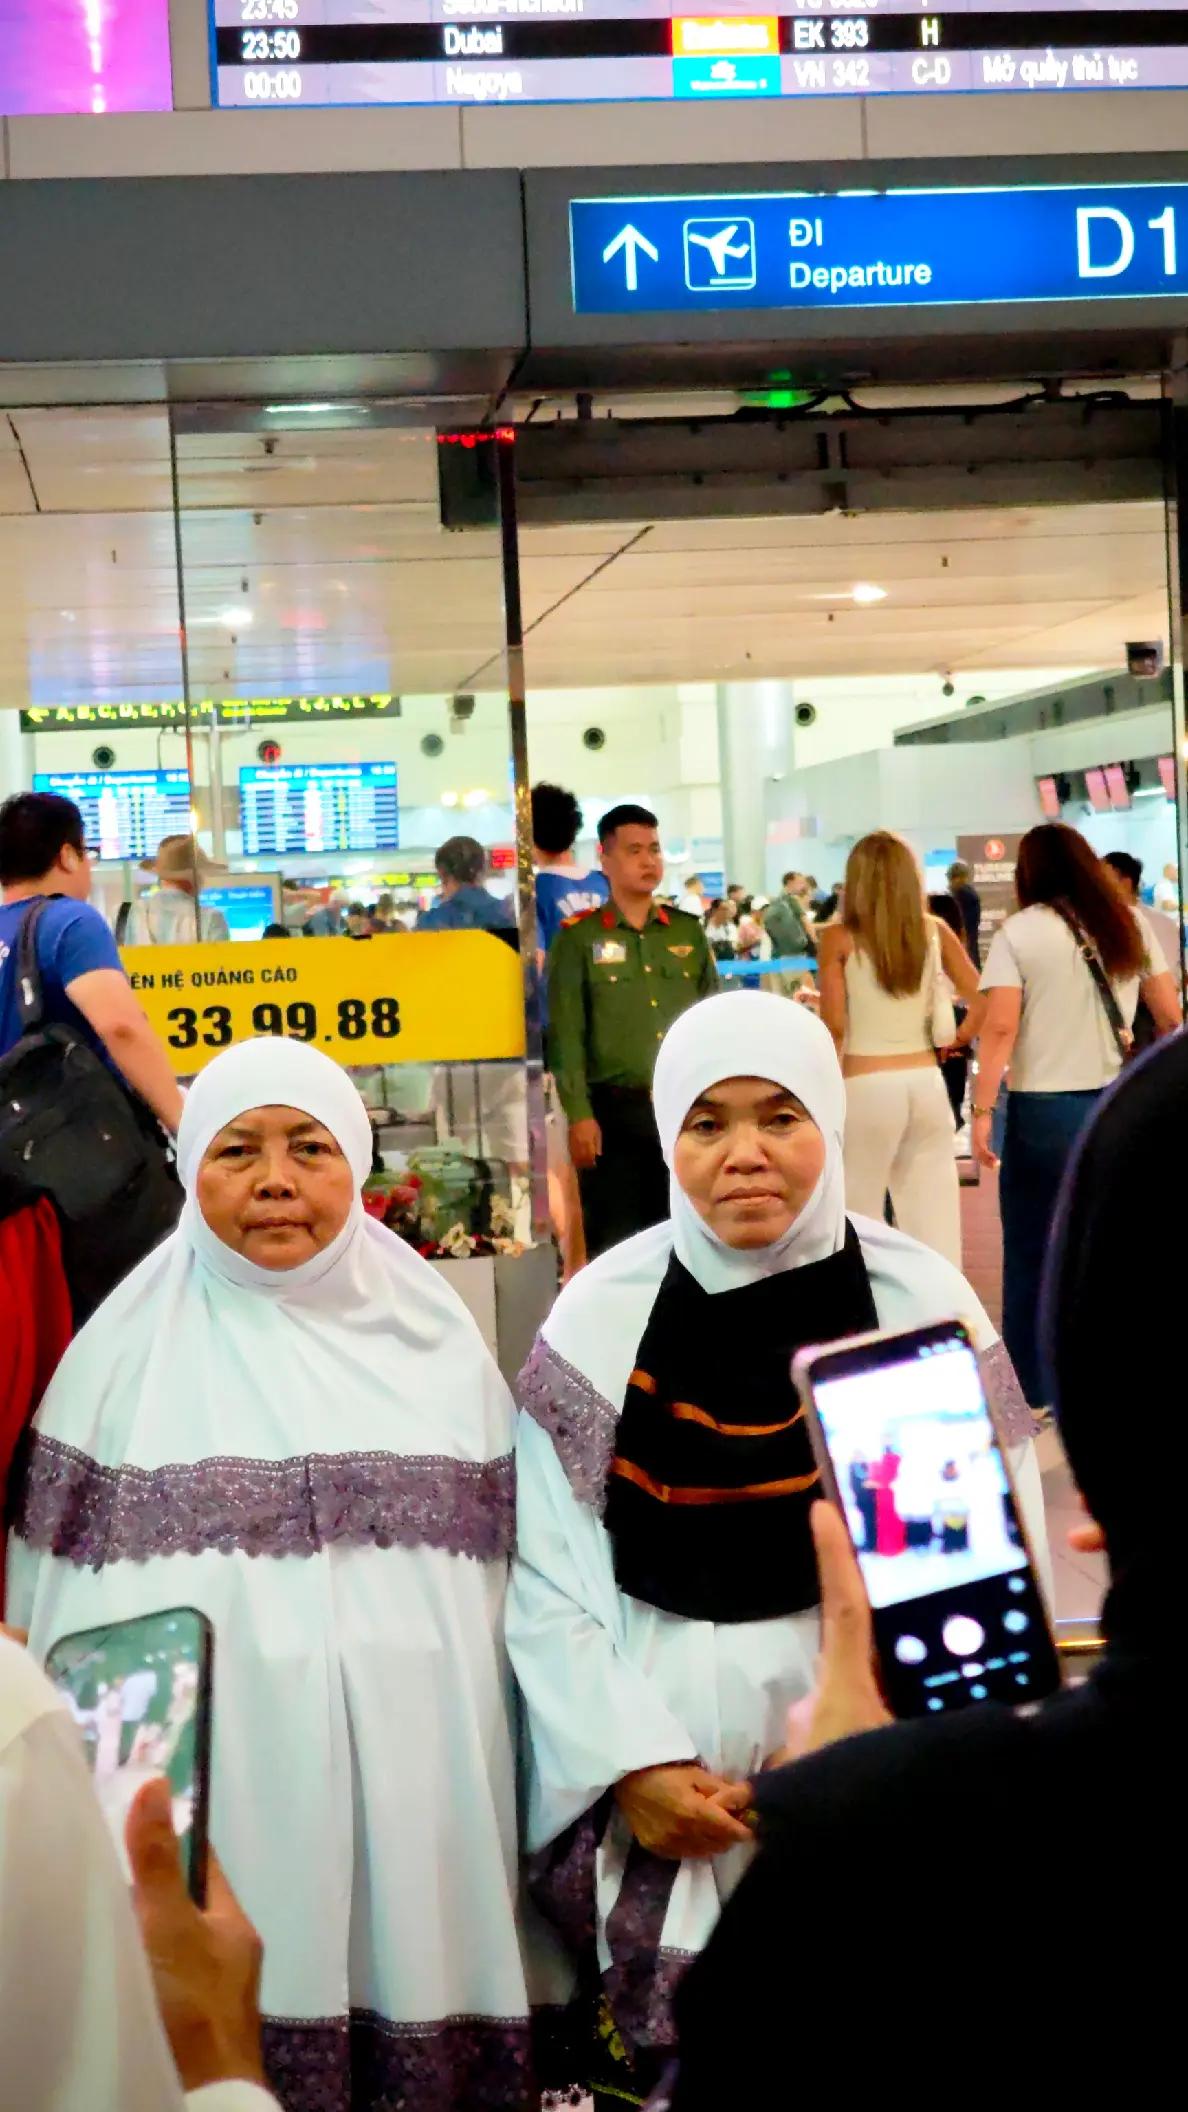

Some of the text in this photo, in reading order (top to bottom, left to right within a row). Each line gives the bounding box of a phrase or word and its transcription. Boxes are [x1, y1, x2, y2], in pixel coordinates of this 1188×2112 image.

[242, 31, 300, 59] 23:50
[444, 25, 503, 55] Dubai
[794, 21, 825, 48] EK
[831, 20, 869, 48] 393
[920, 17, 939, 46] H
[244, 71, 301, 99] 00:00
[793, 60, 826, 88] VN
[832, 59, 870, 87] 342
[911, 57, 951, 85] C-D
[789, 217, 823, 247] ĐI
[1076, 206, 1177, 277] D1
[789, 260, 933, 294] Departure
